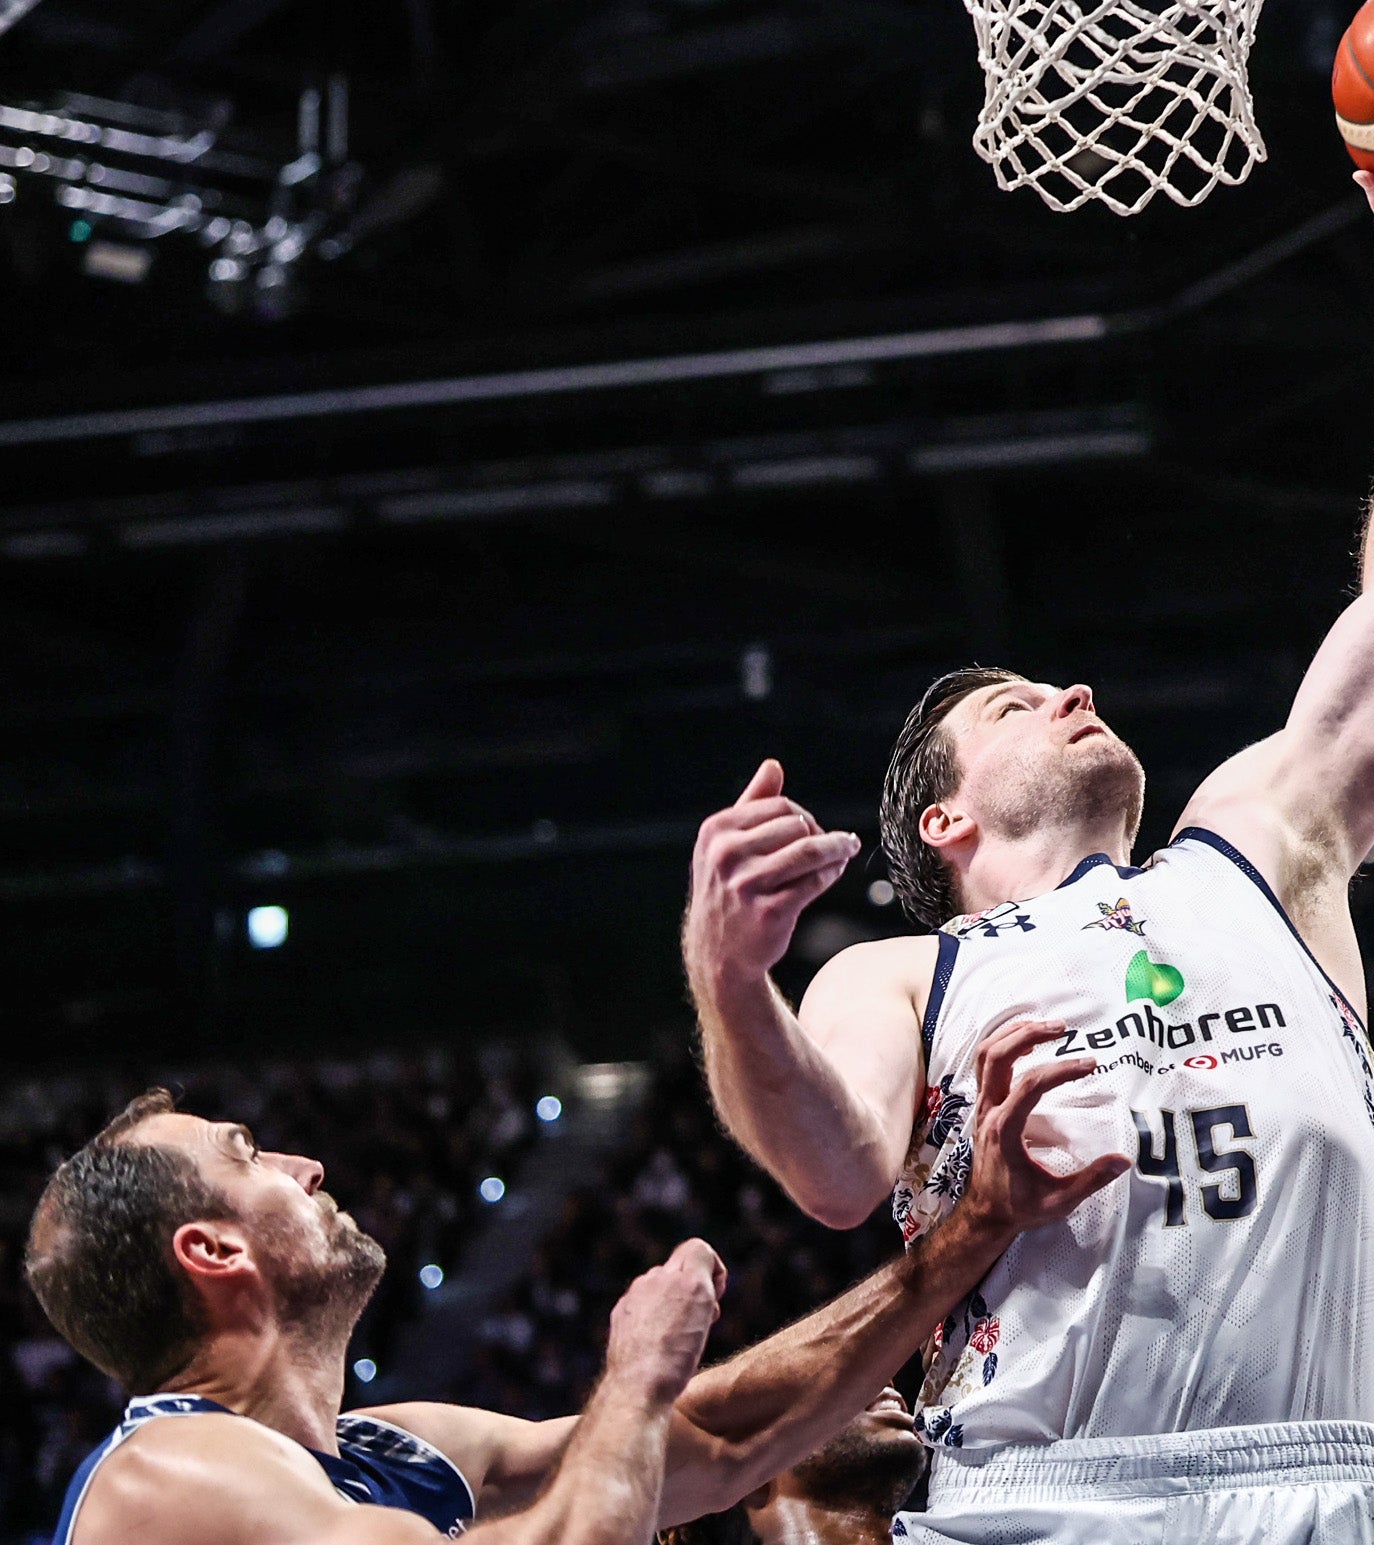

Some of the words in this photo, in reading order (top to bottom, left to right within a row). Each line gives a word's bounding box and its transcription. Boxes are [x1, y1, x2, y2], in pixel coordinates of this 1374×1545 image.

[1055, 1004, 1288, 1056] Zenhoren
[1091, 1051, 1154, 1075] member
[1220, 1043, 1284, 1065] MUFG
[1130, 1101, 1262, 1230] 45
